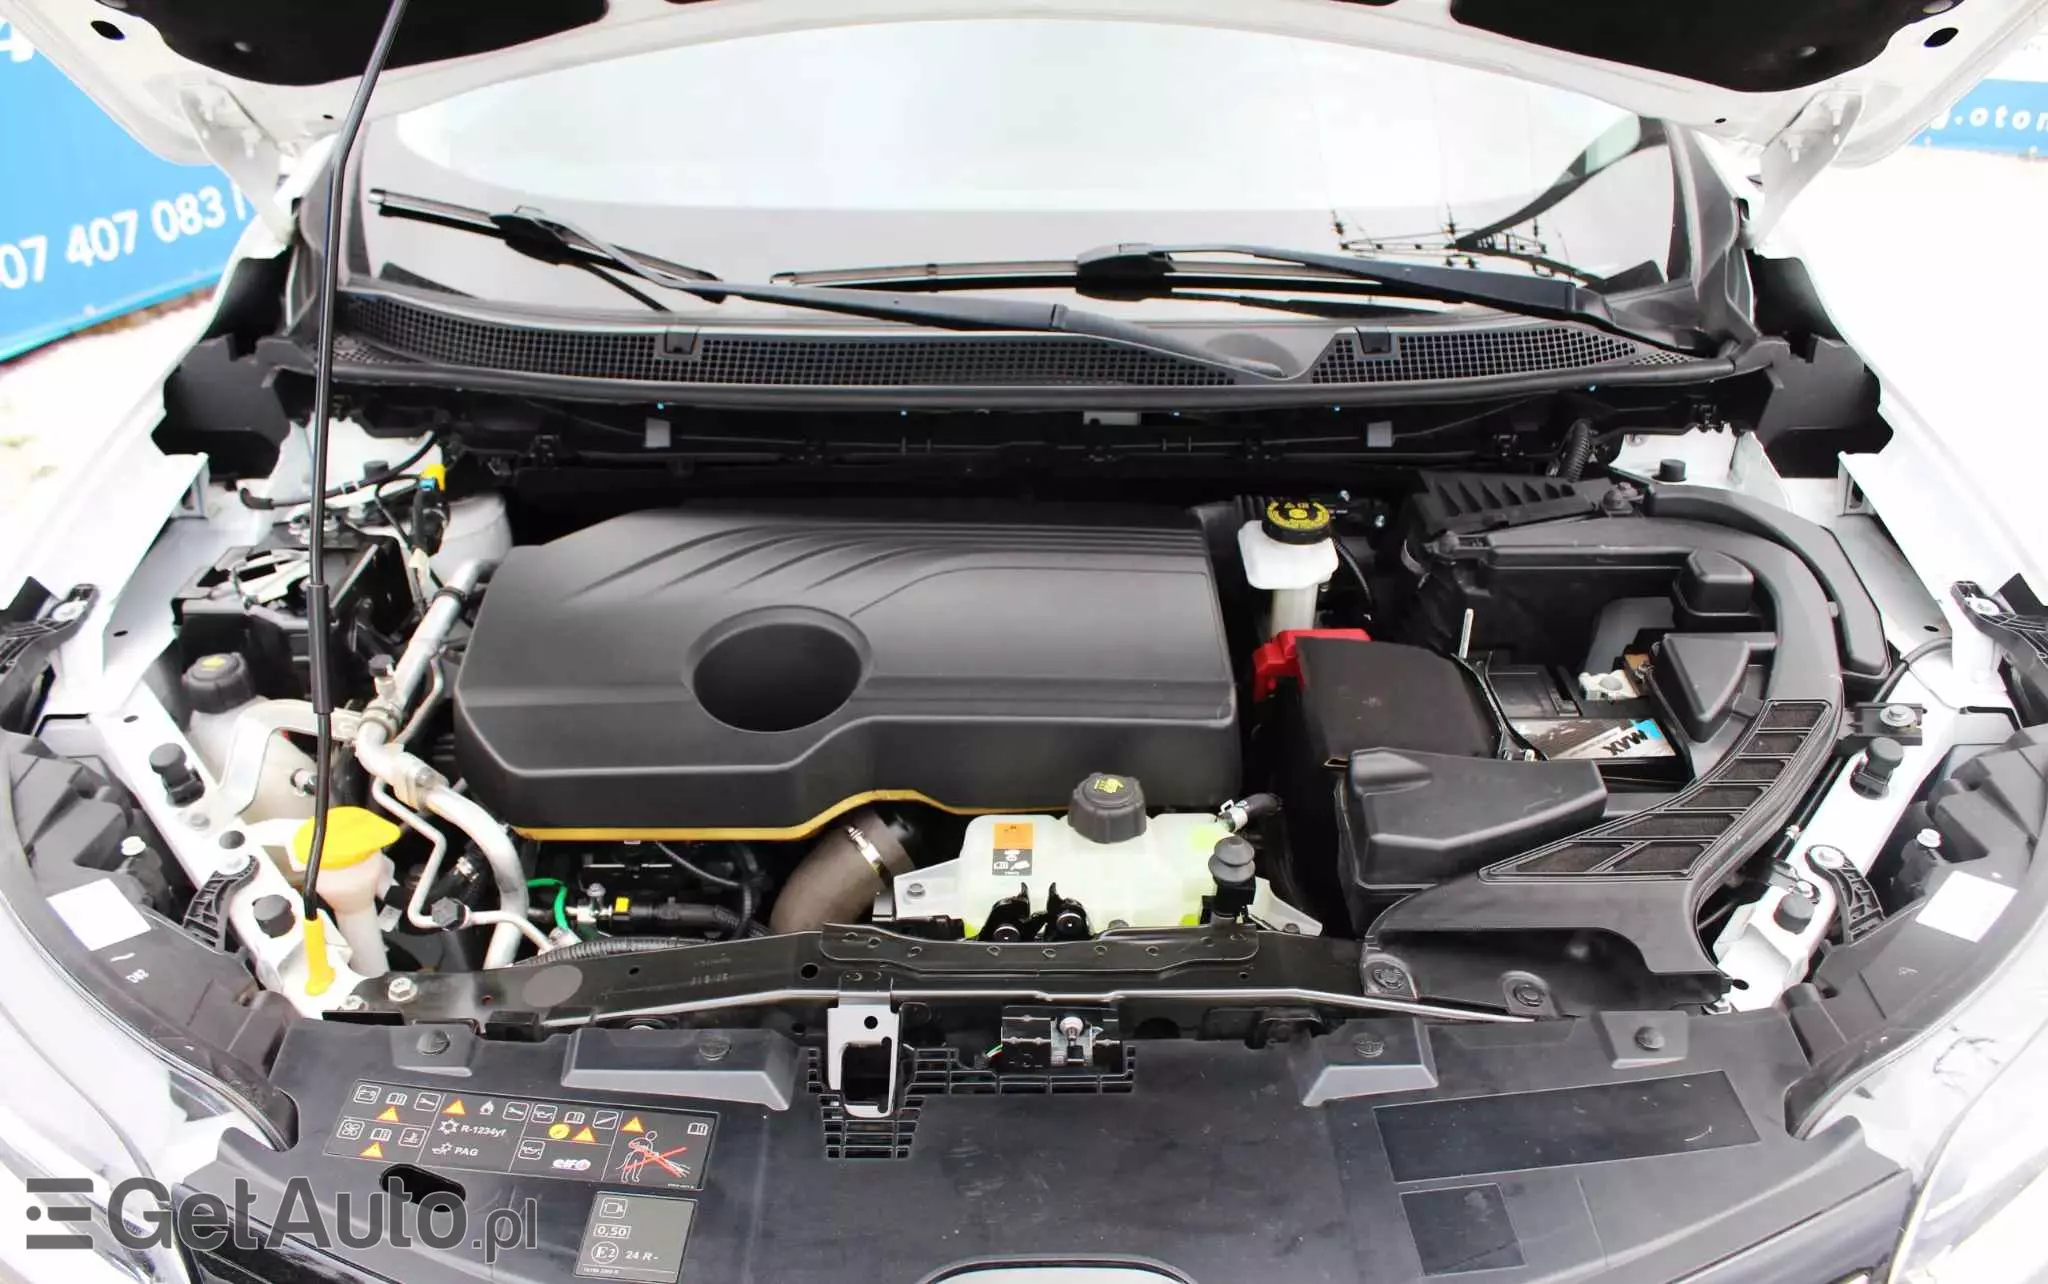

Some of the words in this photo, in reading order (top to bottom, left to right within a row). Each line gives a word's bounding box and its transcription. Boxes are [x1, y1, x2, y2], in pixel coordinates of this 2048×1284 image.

[65, 208, 138, 267] 407
[152, 185, 226, 243] 083
[1602, 729, 1649, 756] MAX
[461, 1124, 507, 1138] R-1234yf
[454, 1146, 479, 1157] PAG
[625, 1250, 640, 1260] 24
